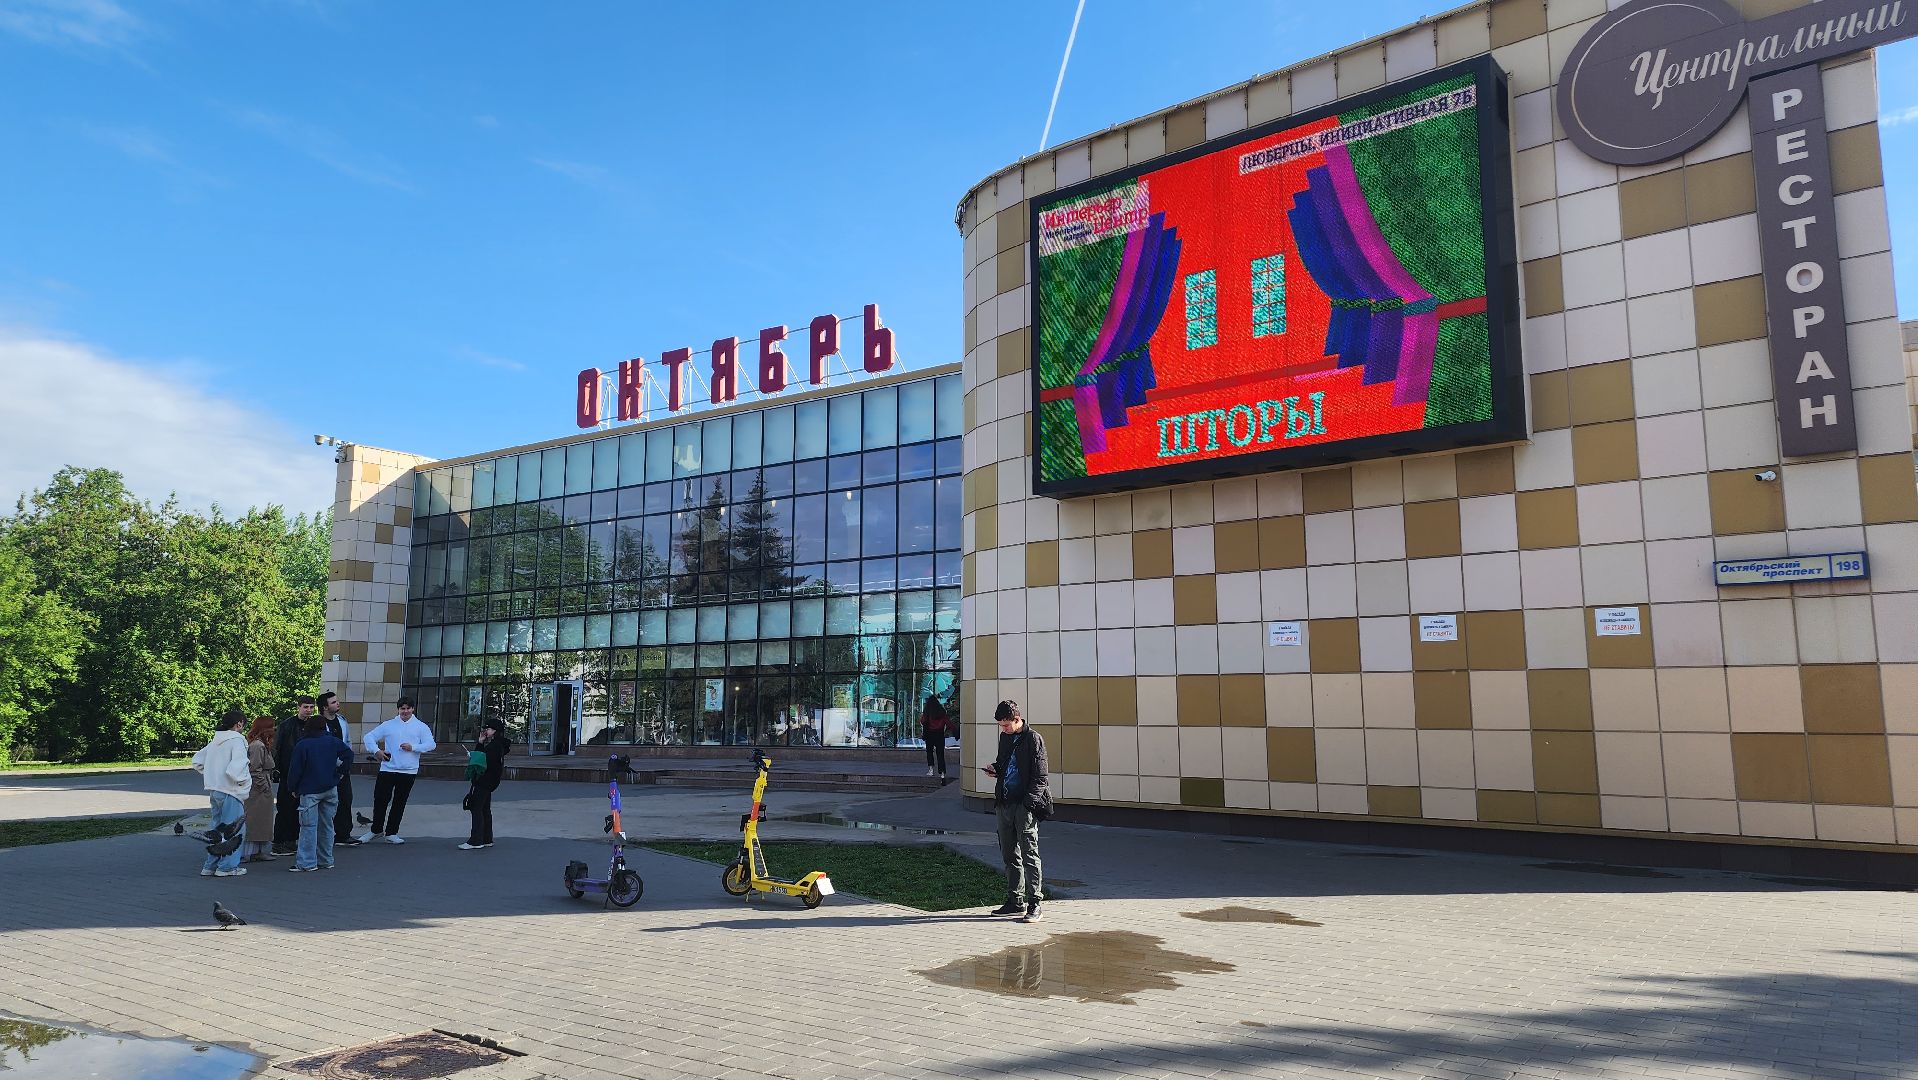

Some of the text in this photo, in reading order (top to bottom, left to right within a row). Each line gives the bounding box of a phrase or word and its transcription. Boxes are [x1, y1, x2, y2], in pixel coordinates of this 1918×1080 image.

[1319, 98, 1449, 147] ИНИЦИАТИВНАЯ
[1771, 87, 1837, 430] РЕСТОРАН
[576, 303, 895, 429] ОКТЯБРЬ
[1156, 391, 1327, 458] ШТОРЫ
[1720, 560, 1860, 573] Октябрьский 198
[1762, 567, 1824, 580] проспект
